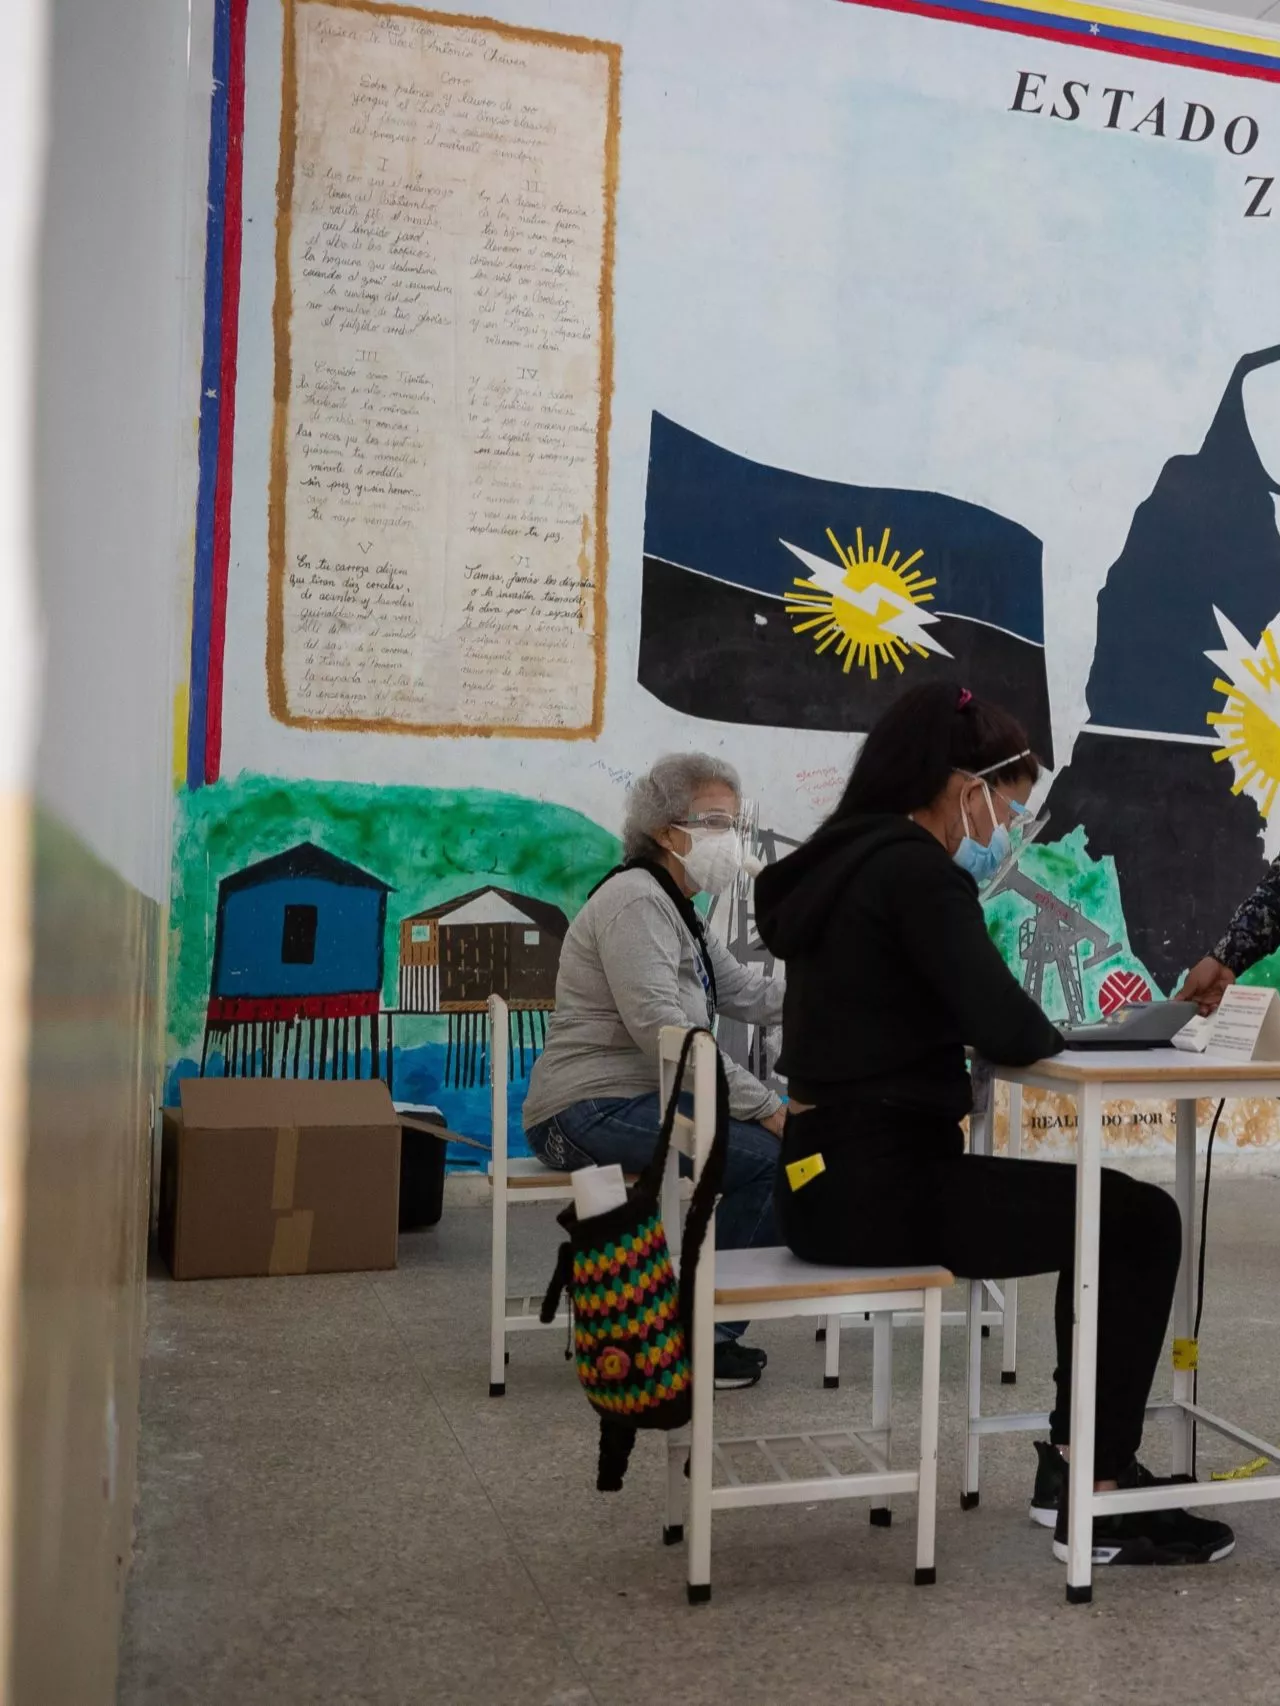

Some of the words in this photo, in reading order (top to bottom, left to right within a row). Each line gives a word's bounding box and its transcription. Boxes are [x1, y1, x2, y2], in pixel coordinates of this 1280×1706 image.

[1008, 71, 1260, 155] ESTADO
[296, 423, 313, 439] las
[308, 507, 324, 522] tu
[524, 525, 540, 539] tu
[296, 553, 312, 570] En
[1132, 1112, 1163, 1125] POR
